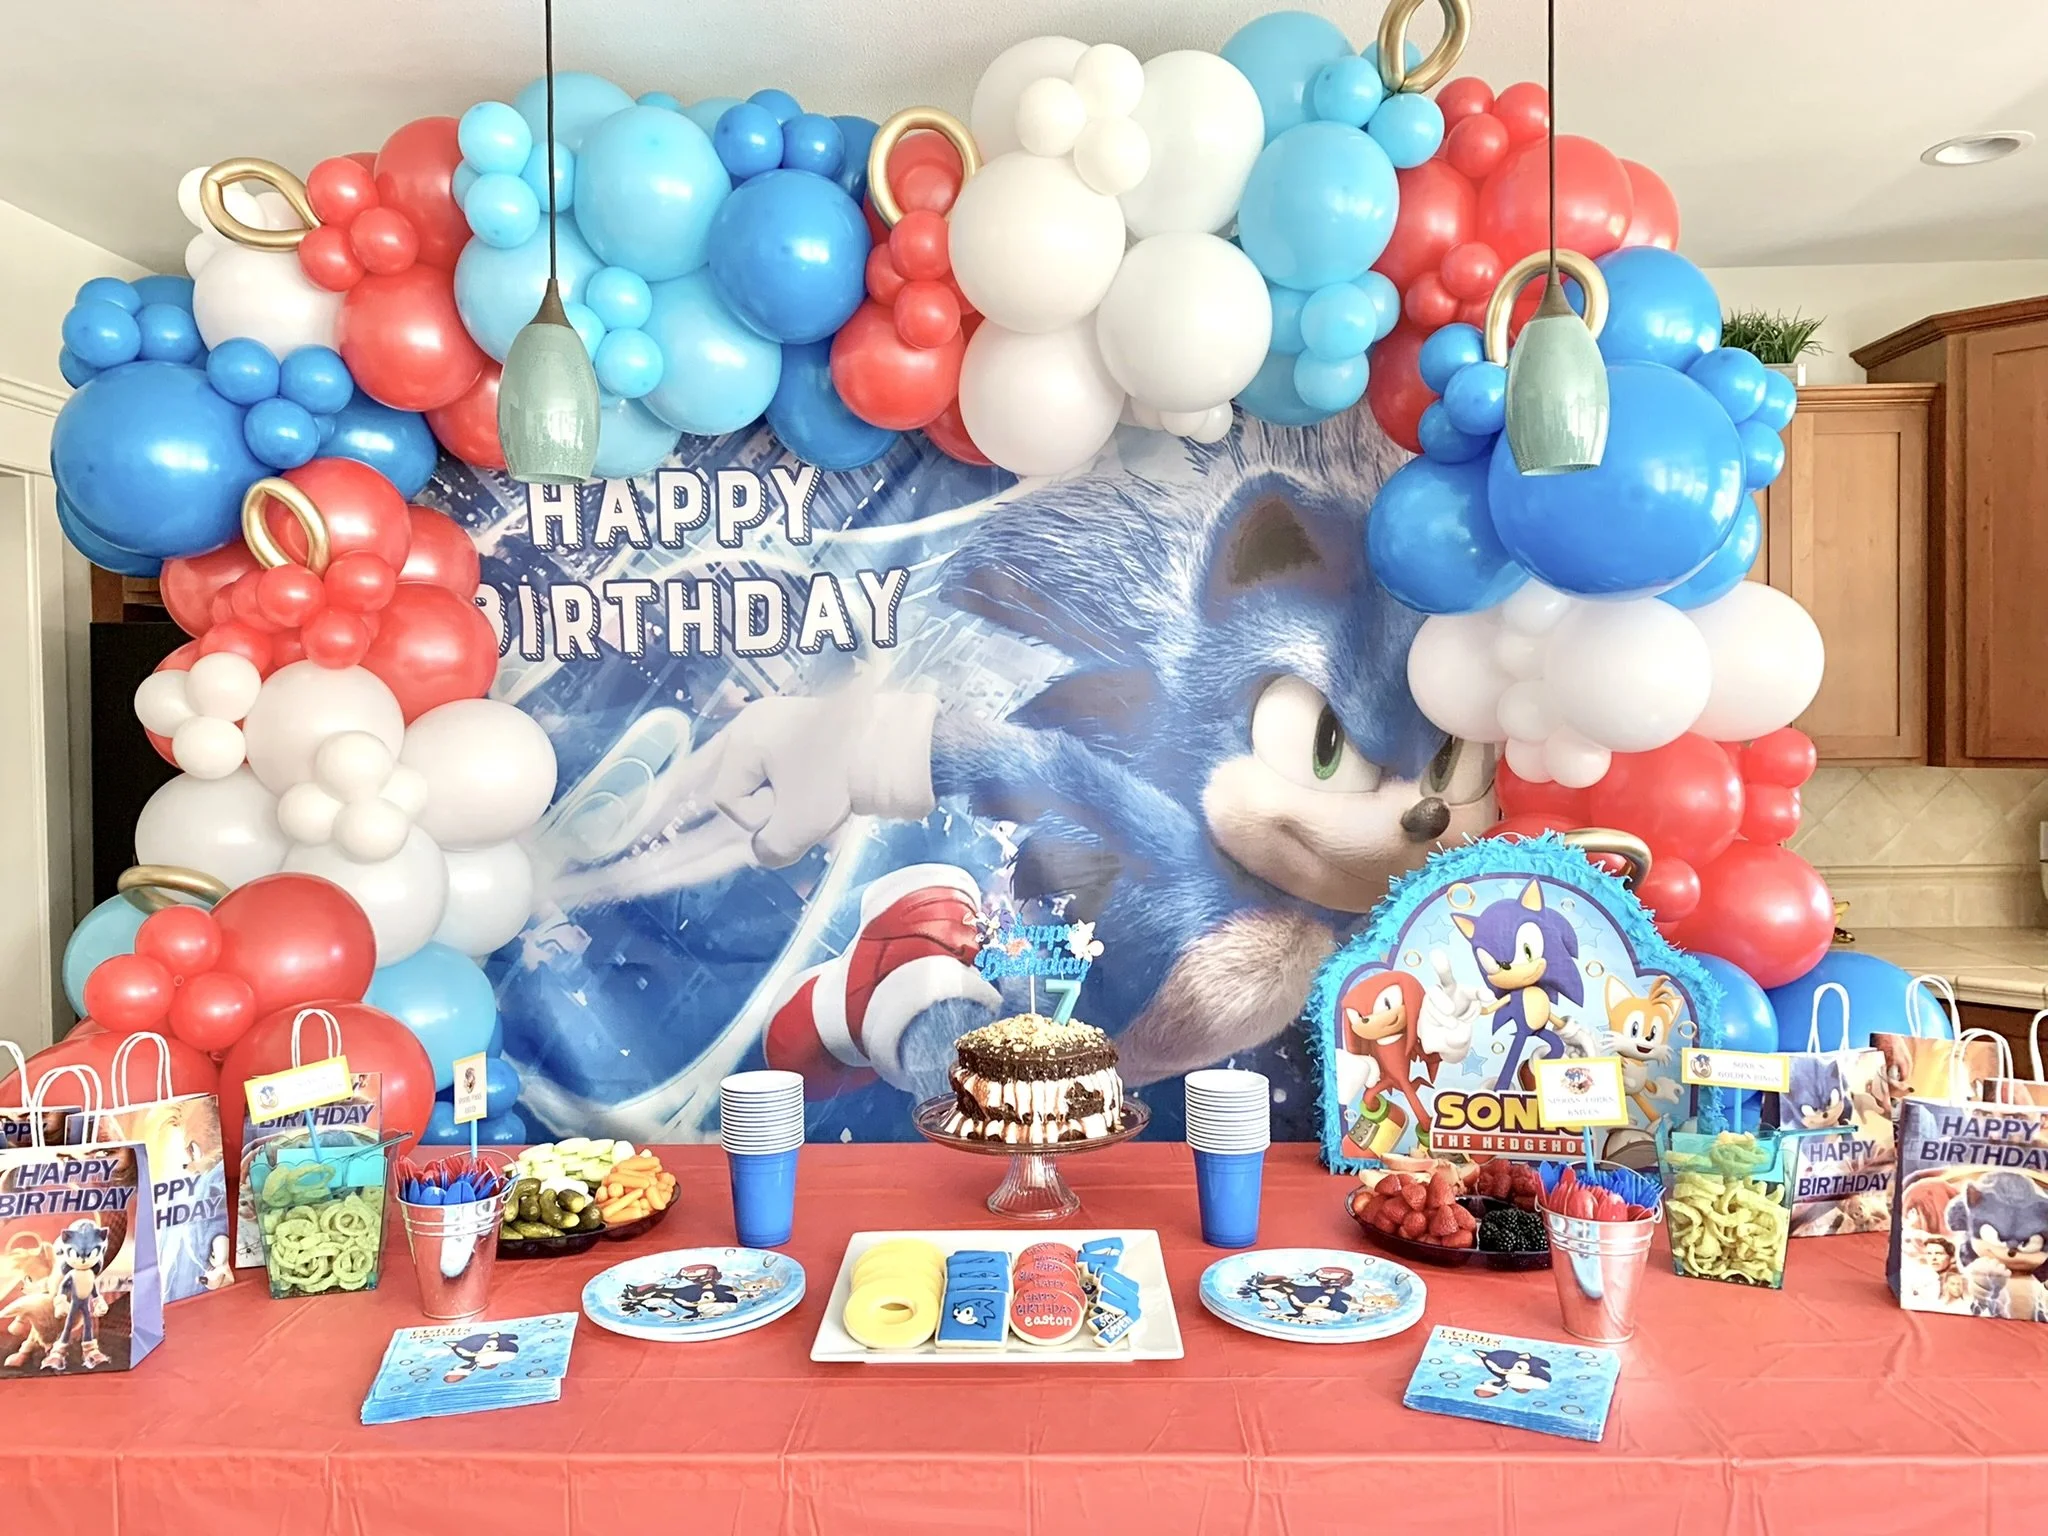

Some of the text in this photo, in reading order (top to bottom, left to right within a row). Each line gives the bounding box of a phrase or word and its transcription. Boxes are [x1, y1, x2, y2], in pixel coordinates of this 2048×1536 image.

[526, 465, 825, 552] HAPPY
[1045, 978, 1082, 1027] 7
[1434, 1091, 1592, 1136] SON
[1941, 1115, 2041, 1141] HAPPY
[1434, 1133, 1472, 1149] THE
[1809, 1139, 1876, 1163] HAPPY
[17, 1158, 120, 1188] HAPPY
[1798, 1172, 1893, 1197] BIRTHDAY
[0, 1186, 136, 1218] BIRTHDAY
[1016, 1302, 1075, 1316] BIRTHDAY
[1023, 1292, 1058, 1302] HAPPY
[1024, 1314, 1073, 1327] easton
